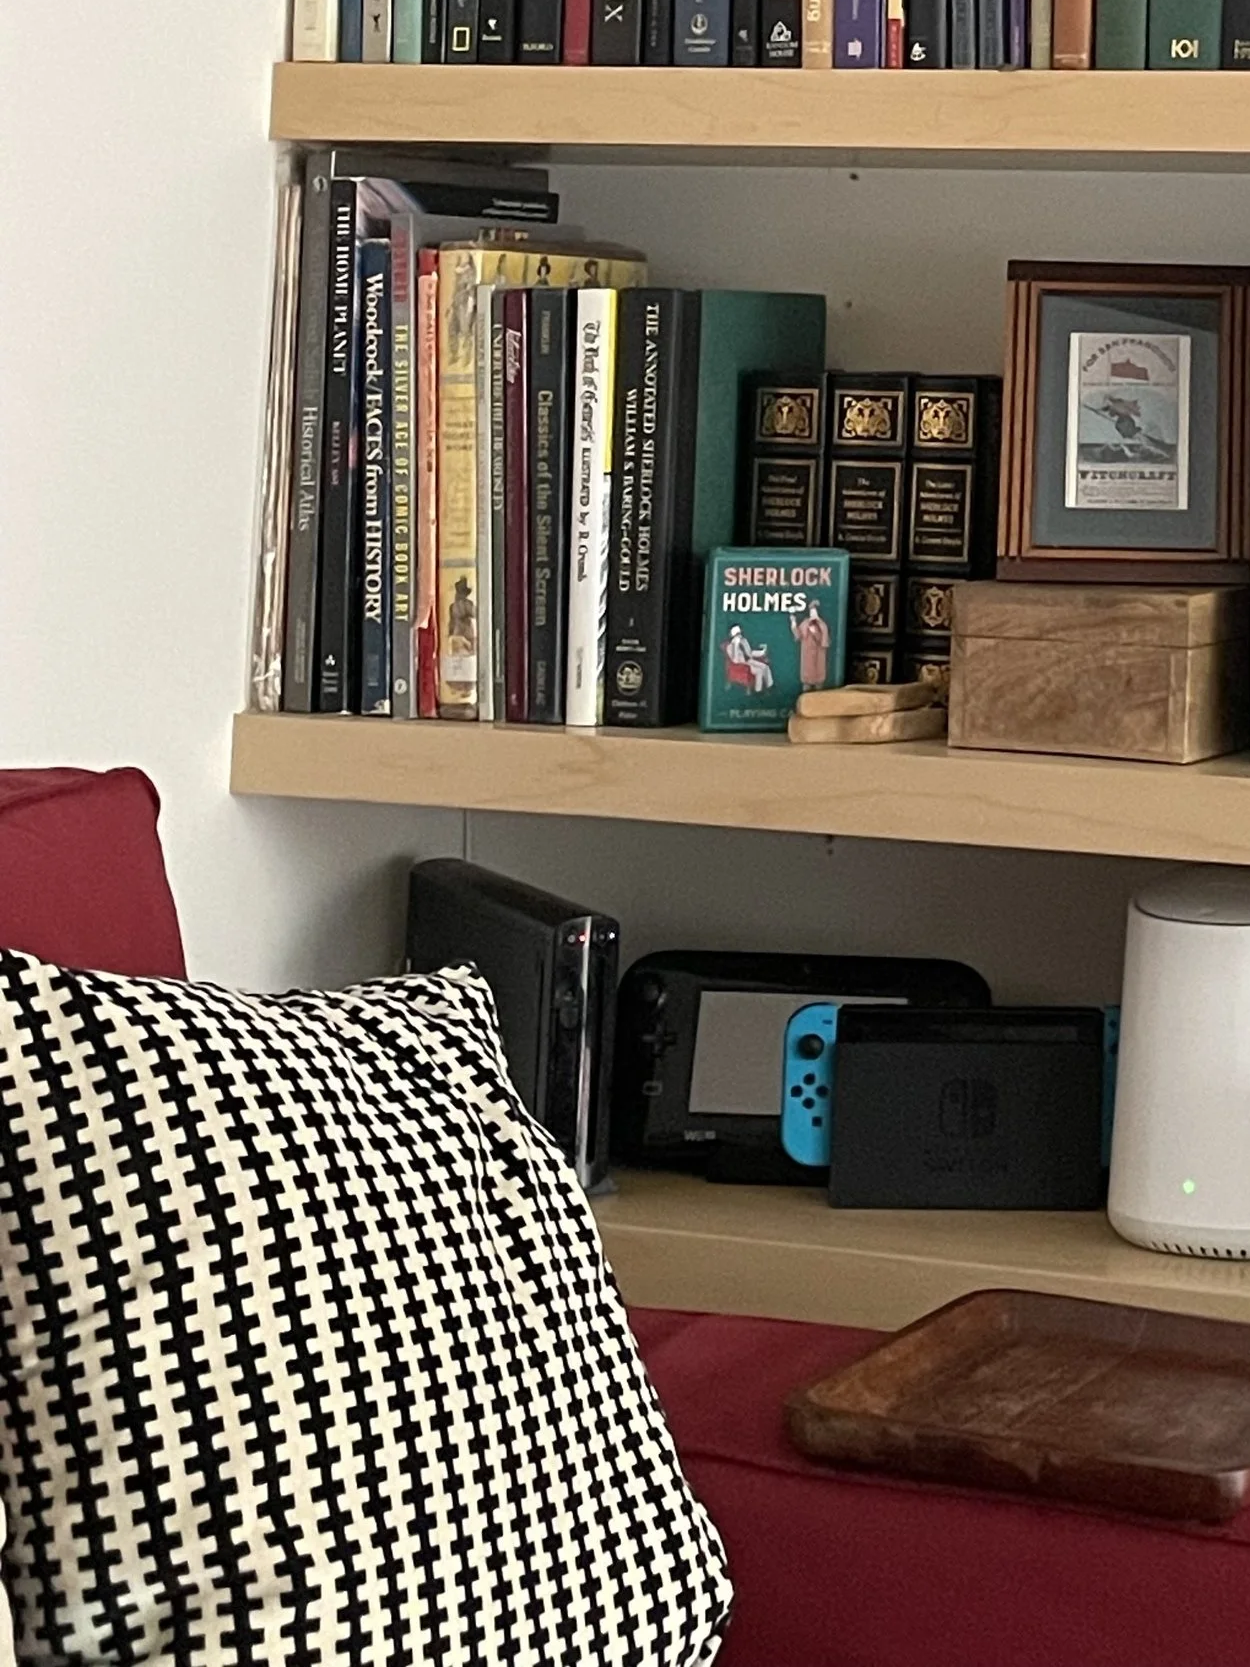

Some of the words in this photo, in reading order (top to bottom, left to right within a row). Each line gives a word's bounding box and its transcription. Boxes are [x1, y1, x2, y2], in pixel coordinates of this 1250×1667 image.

[335, 205, 349, 242] THE
[334, 246, 349, 300] HOME
[395, 323, 408, 350] THE
[643, 303, 658, 335] THE
[332, 306, 348, 376] PLANET
[395, 359, 408, 411] SILVER
[639, 340, 658, 433] ANNOTATED
[394, 421, 408, 449] AGE
[537, 390, 552, 457] Classics
[299, 406, 317, 486] Historical
[394, 456, 408, 474] OF
[536, 461, 551, 478] of
[637, 439, 657, 519] SHERLOCK
[1079, 470, 1177, 481] WITCHCRAFT
[298, 491, 314, 531] Atlas
[394, 484, 408, 533] COMIC
[536, 483, 551, 509] the
[536, 514, 551, 561] Silent
[634, 525, 655, 591] HOLMES
[394, 540, 408, 583] BOOK
[723, 567, 832, 587] SHERLOCK
[394, 593, 408, 621] ART
[535, 567, 550, 625] Screen
[722, 592, 807, 613] HOLMES
